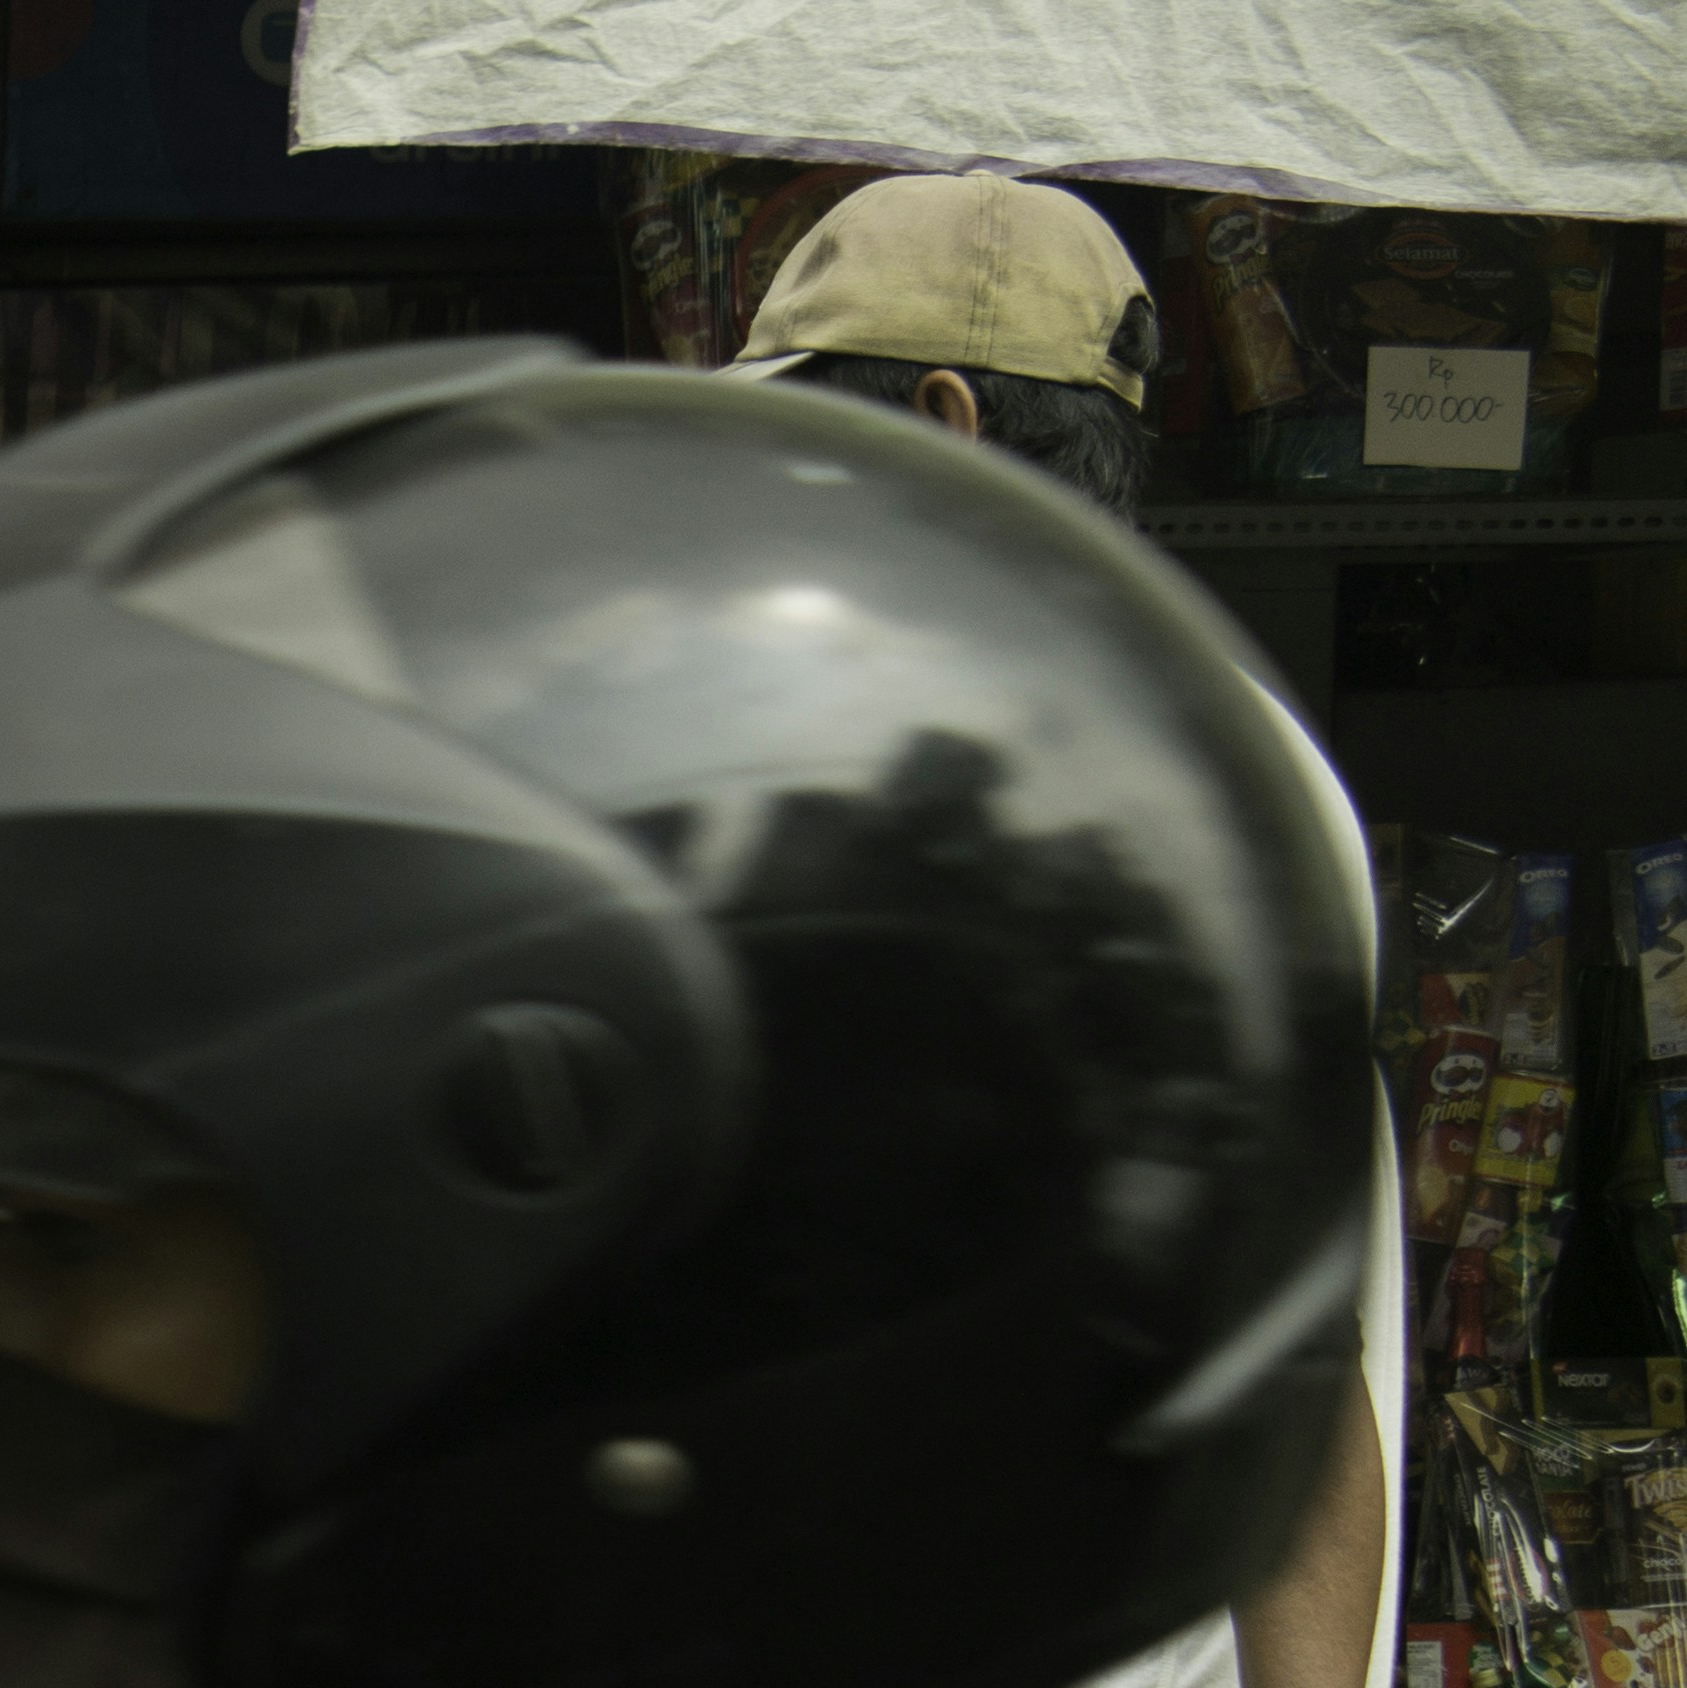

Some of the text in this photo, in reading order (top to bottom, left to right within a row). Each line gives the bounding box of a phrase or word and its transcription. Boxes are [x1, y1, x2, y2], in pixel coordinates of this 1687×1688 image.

[1383, 245, 1460, 262] Selamat
[1428, 355, 1454, 389] Rp
[1635, 853, 1683, 875] OREO
[1519, 868, 1568, 884] OREO
[1476, 1466, 1502, 1537] COCOLATE
